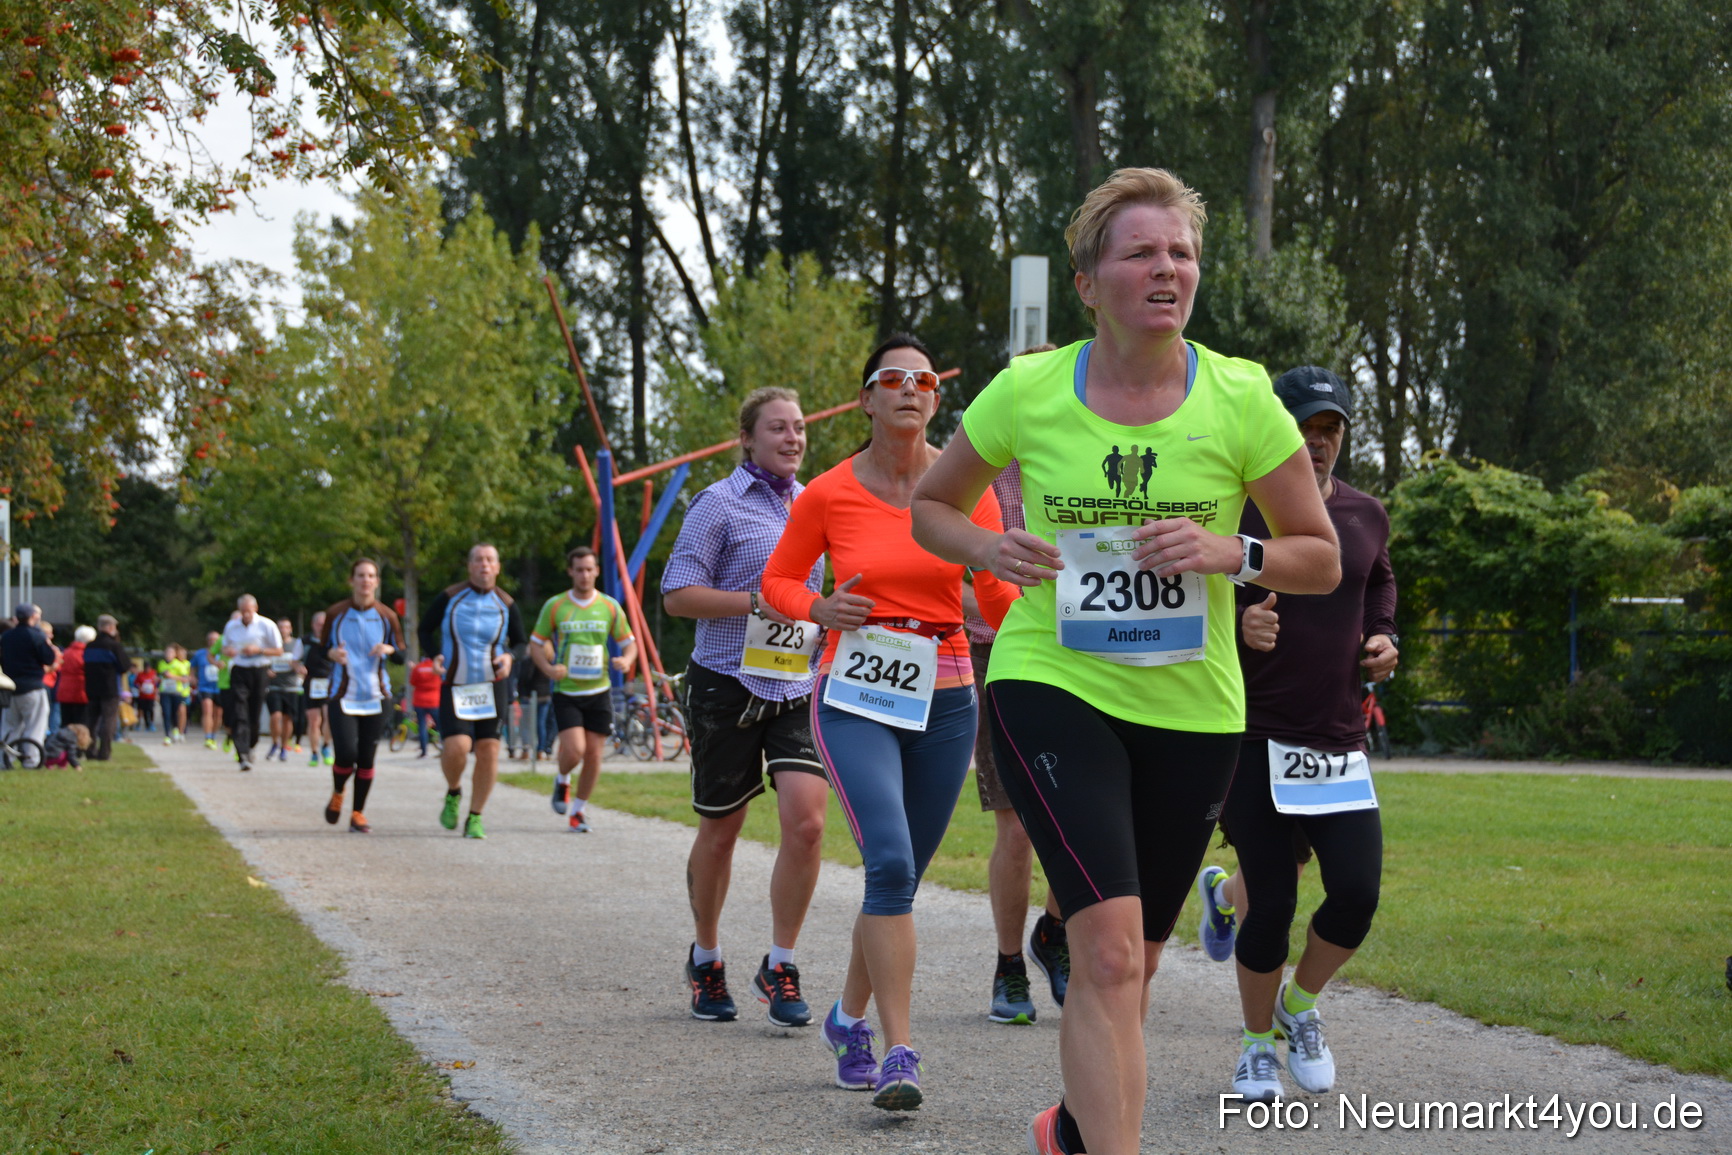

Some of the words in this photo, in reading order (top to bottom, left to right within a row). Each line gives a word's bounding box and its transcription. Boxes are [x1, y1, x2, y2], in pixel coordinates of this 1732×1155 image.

[1043, 494, 1064, 508] SC
[1079, 570, 1186, 612] 2308
[876, 634, 912, 649] BOCK
[1107, 627, 1161, 642] Andrea
[844, 651, 921, 692] 2342
[460, 693, 488, 706] 2702
[858, 691, 895, 709] Marion
[1283, 751, 1349, 779] 2917
